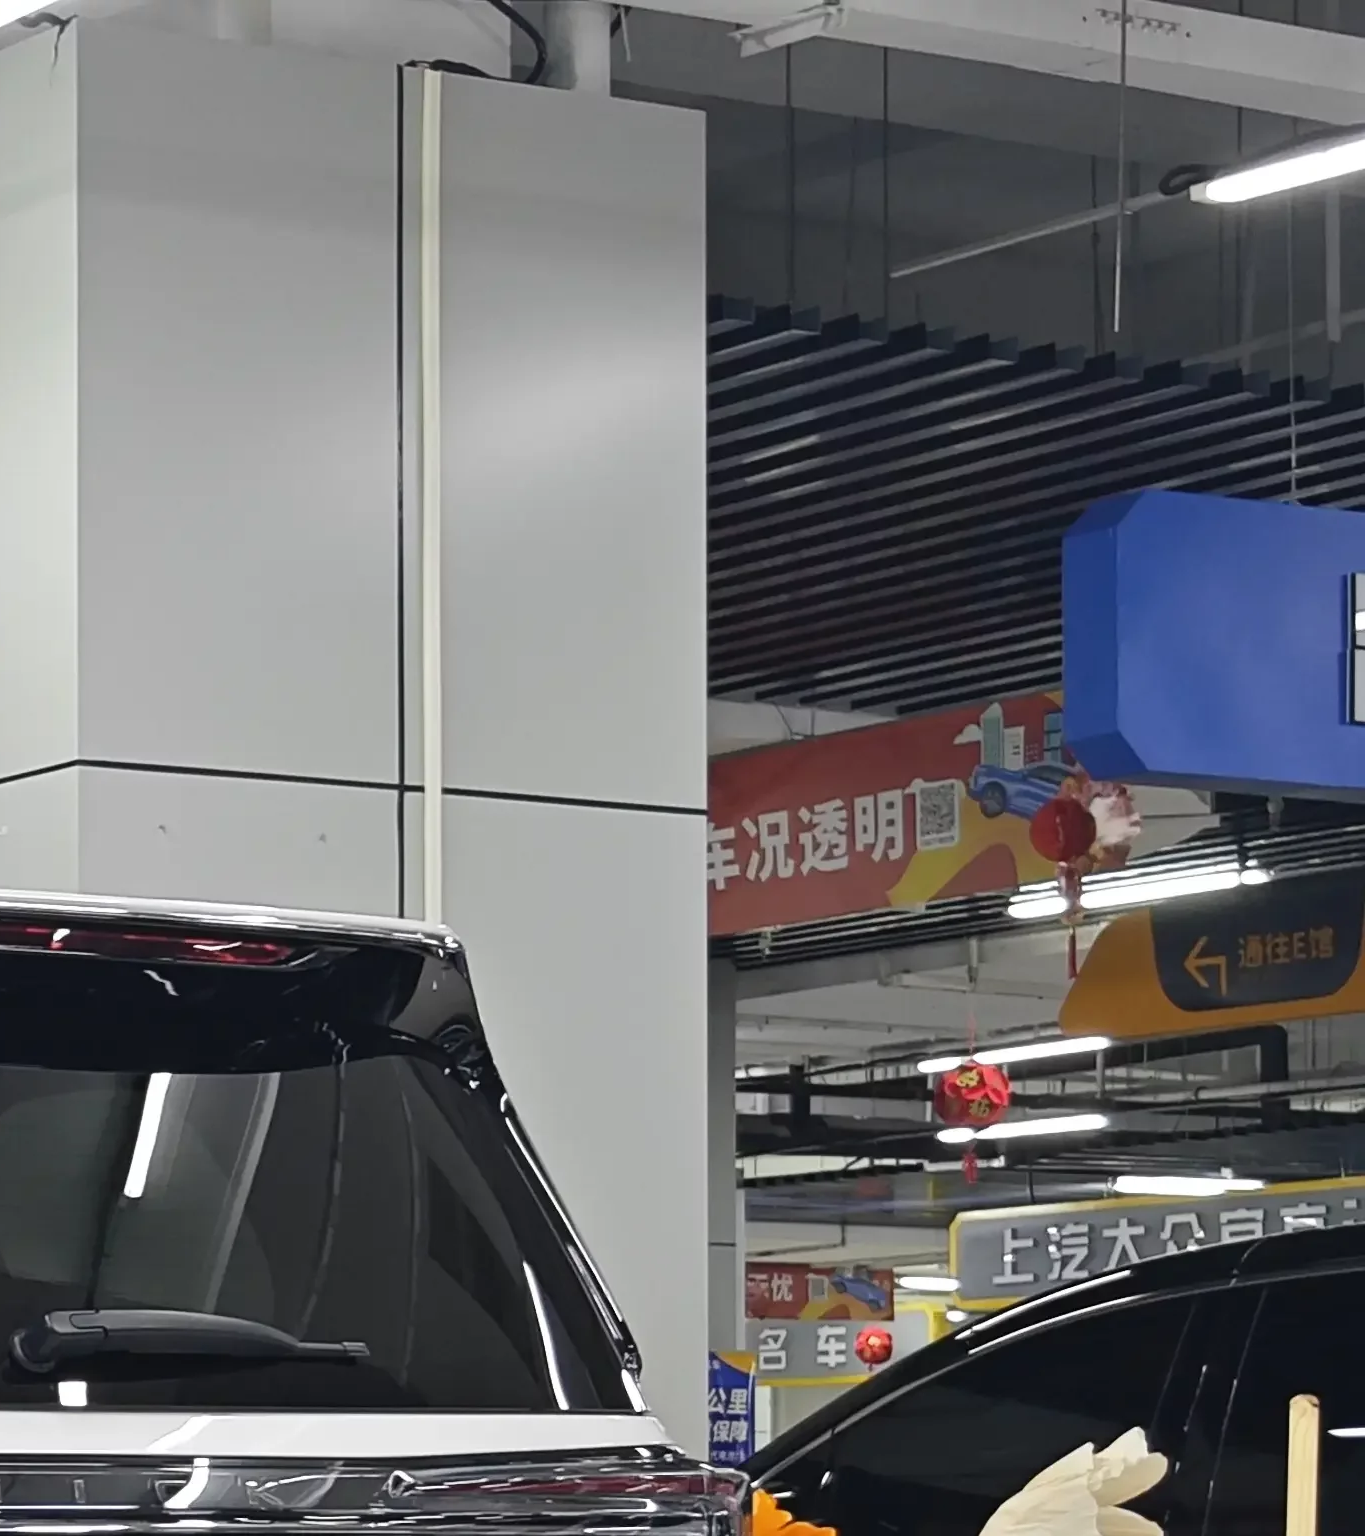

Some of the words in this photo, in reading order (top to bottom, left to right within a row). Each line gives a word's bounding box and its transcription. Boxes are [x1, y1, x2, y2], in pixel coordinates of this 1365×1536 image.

[707, 788, 904, 891] 车况透明
[758, 1324, 847, 1370] 名车
